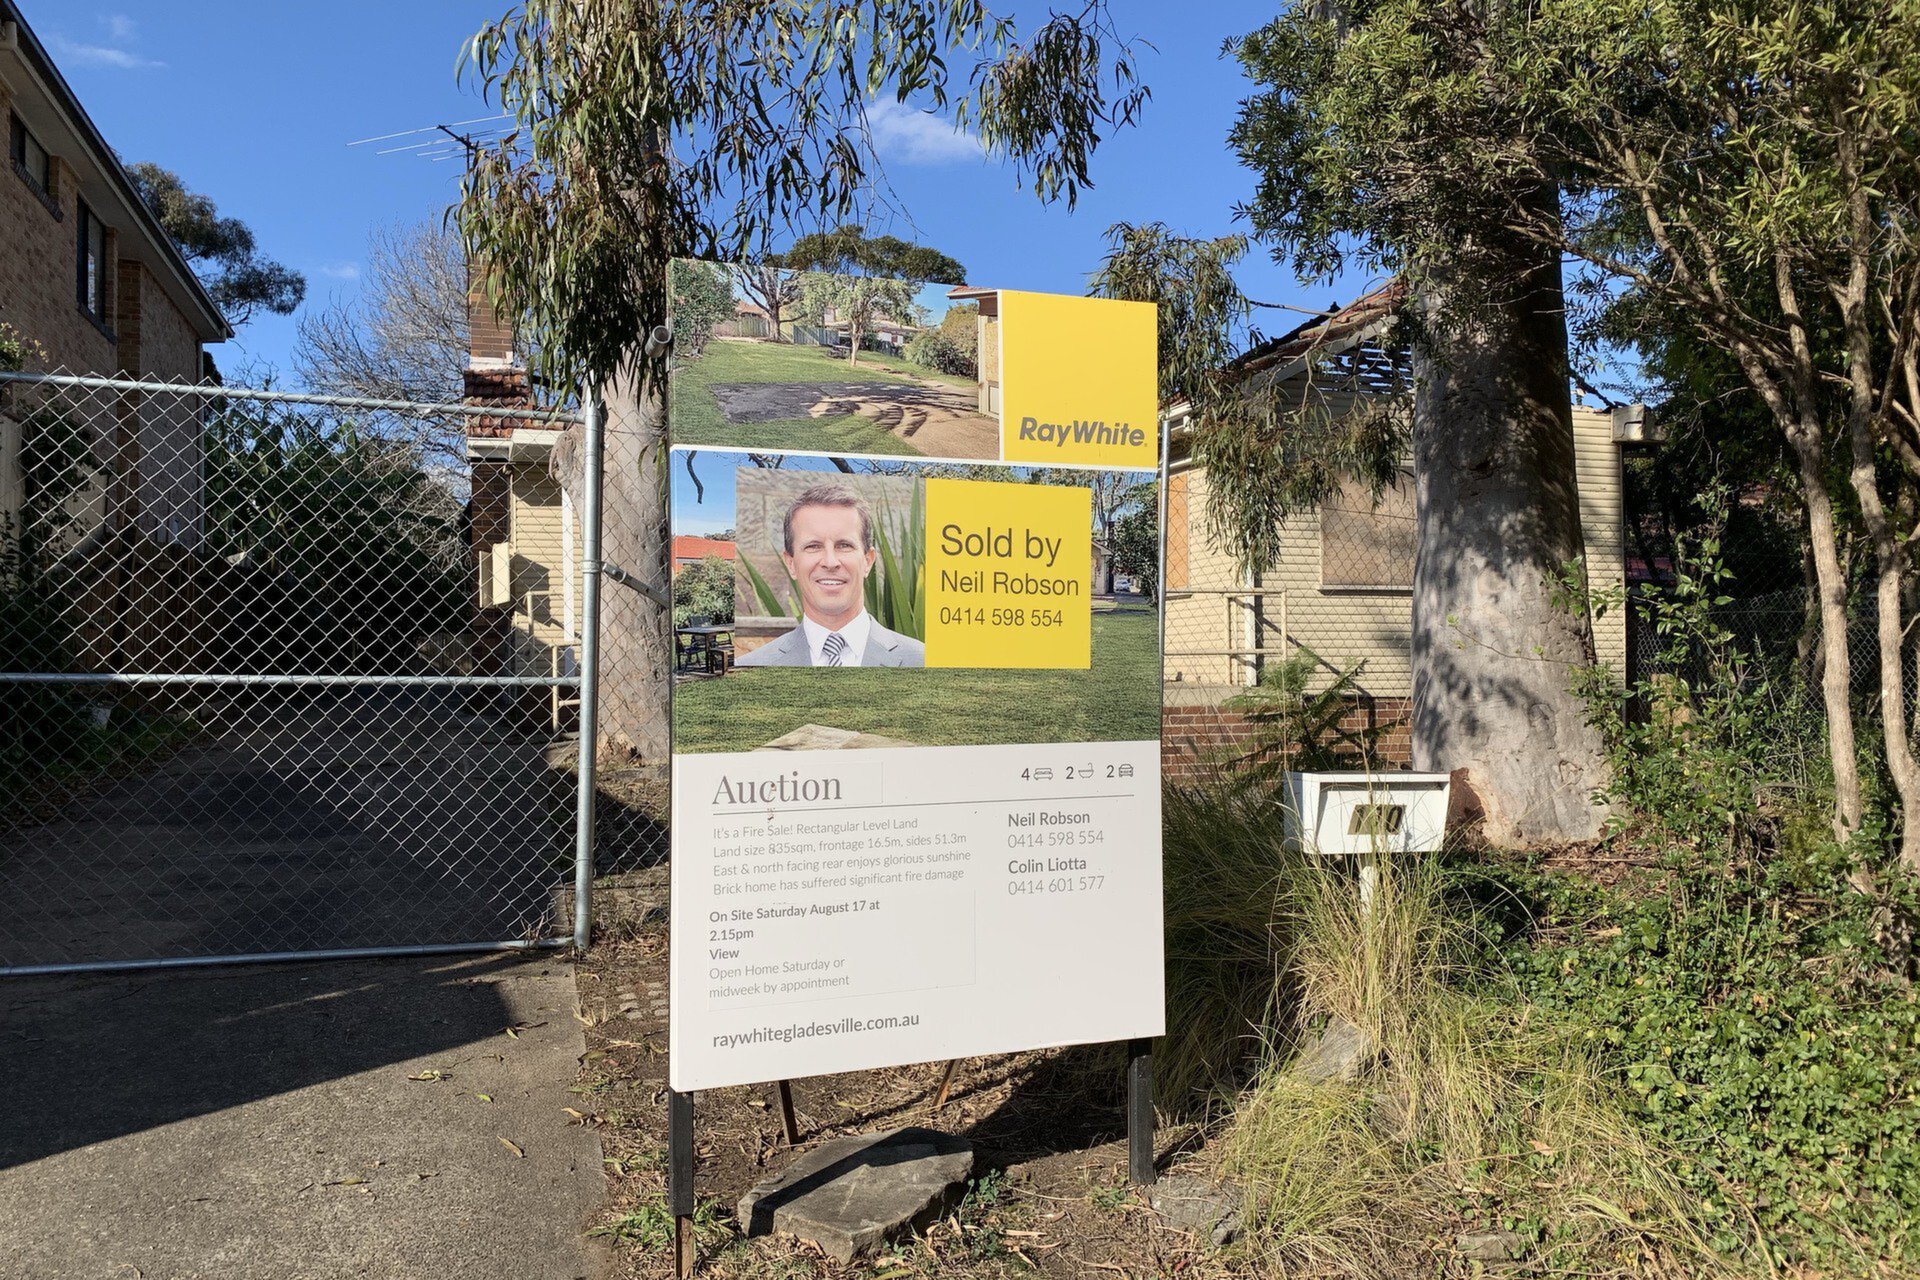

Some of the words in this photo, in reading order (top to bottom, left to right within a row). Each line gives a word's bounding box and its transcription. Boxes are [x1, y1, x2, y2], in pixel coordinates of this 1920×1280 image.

[941, 524, 1012, 557] Sold
[1026, 529, 1061, 567] by
[941, 570, 984, 593] Neil
[993, 572, 1078, 596] Robson
[940, 606, 985, 626] 0414
[992, 607, 1025, 626] 598
[1031, 608, 1063, 627] 554
[1021, 768, 1030, 781] 4
[1066, 766, 1074, 779] 2
[1107, 765, 1114, 778] 2
[712, 771, 842, 805] Auction
[733, 830, 739, 838] a
[743, 827, 764, 838] Fire
[768, 825, 793, 836] Sale!
[797, 821, 859, 836] Rectangular
[863, 819, 890, 831] Level
[893, 818, 918, 829] Land
[1008, 813, 1035, 827] Neil
[1040, 811, 1090, 826] Robson
[714, 846, 741, 858] Land
[744, 845, 765, 856] size
[769, 843, 816, 857] 835sqm,
[819, 839, 864, 854] frontage
[868, 837, 903, 849] 16.5m,
[906, 835, 931, 846] sides
[935, 833, 967, 845] 51.3m
[1008, 834, 1043, 848] 0414
[1049, 832, 1074, 846] 598
[1079, 830, 1104, 844] 554
[714, 865, 738, 876] East
[741, 864, 749, 874] &
[754, 862, 783, 873] north
[787, 859, 819, 874] facing
[823, 859, 843, 869] rear
[847, 856, 881, 870] enjoys
[884, 853, 923, 866] glorious
[927, 851, 971, 862] sunshine
[1008, 859, 1043, 873] Colin
[1048, 858, 1086, 871] Liotta
[714, 883, 742, 895] Brick
[745, 881, 776, 893] home
[780, 879, 798, 891] has
[802, 876, 846, 889] suffered
[849, 872, 901, 888] significant
[905, 871, 922, 882] fire
[925, 868, 964, 882] damage
[1008, 881, 1043, 895] 0414
[1049, 878, 1073, 892] 601
[1080, 876, 1104, 890] 577
[709, 911, 727, 922] On
[731, 909, 753, 921] Site
[757, 904, 807, 920] Saturday
[810, 902, 849, 916] August
[852, 901, 866, 912] 17
[869, 900, 880, 910] at
[709, 928, 754, 944] 2.15pm
[709, 948, 739, 960] View
[709, 967, 741, 982] Open
[745, 963, 779, 976] Home
[783, 958, 830, 974] Saturday
[834, 957, 845, 968] or
[709, 984, 760, 998] midweek
[764, 983, 777, 995] by
[780, 975, 850, 992] appointment
[713, 1013, 920, 1048] raywhitegladesville.com.au
